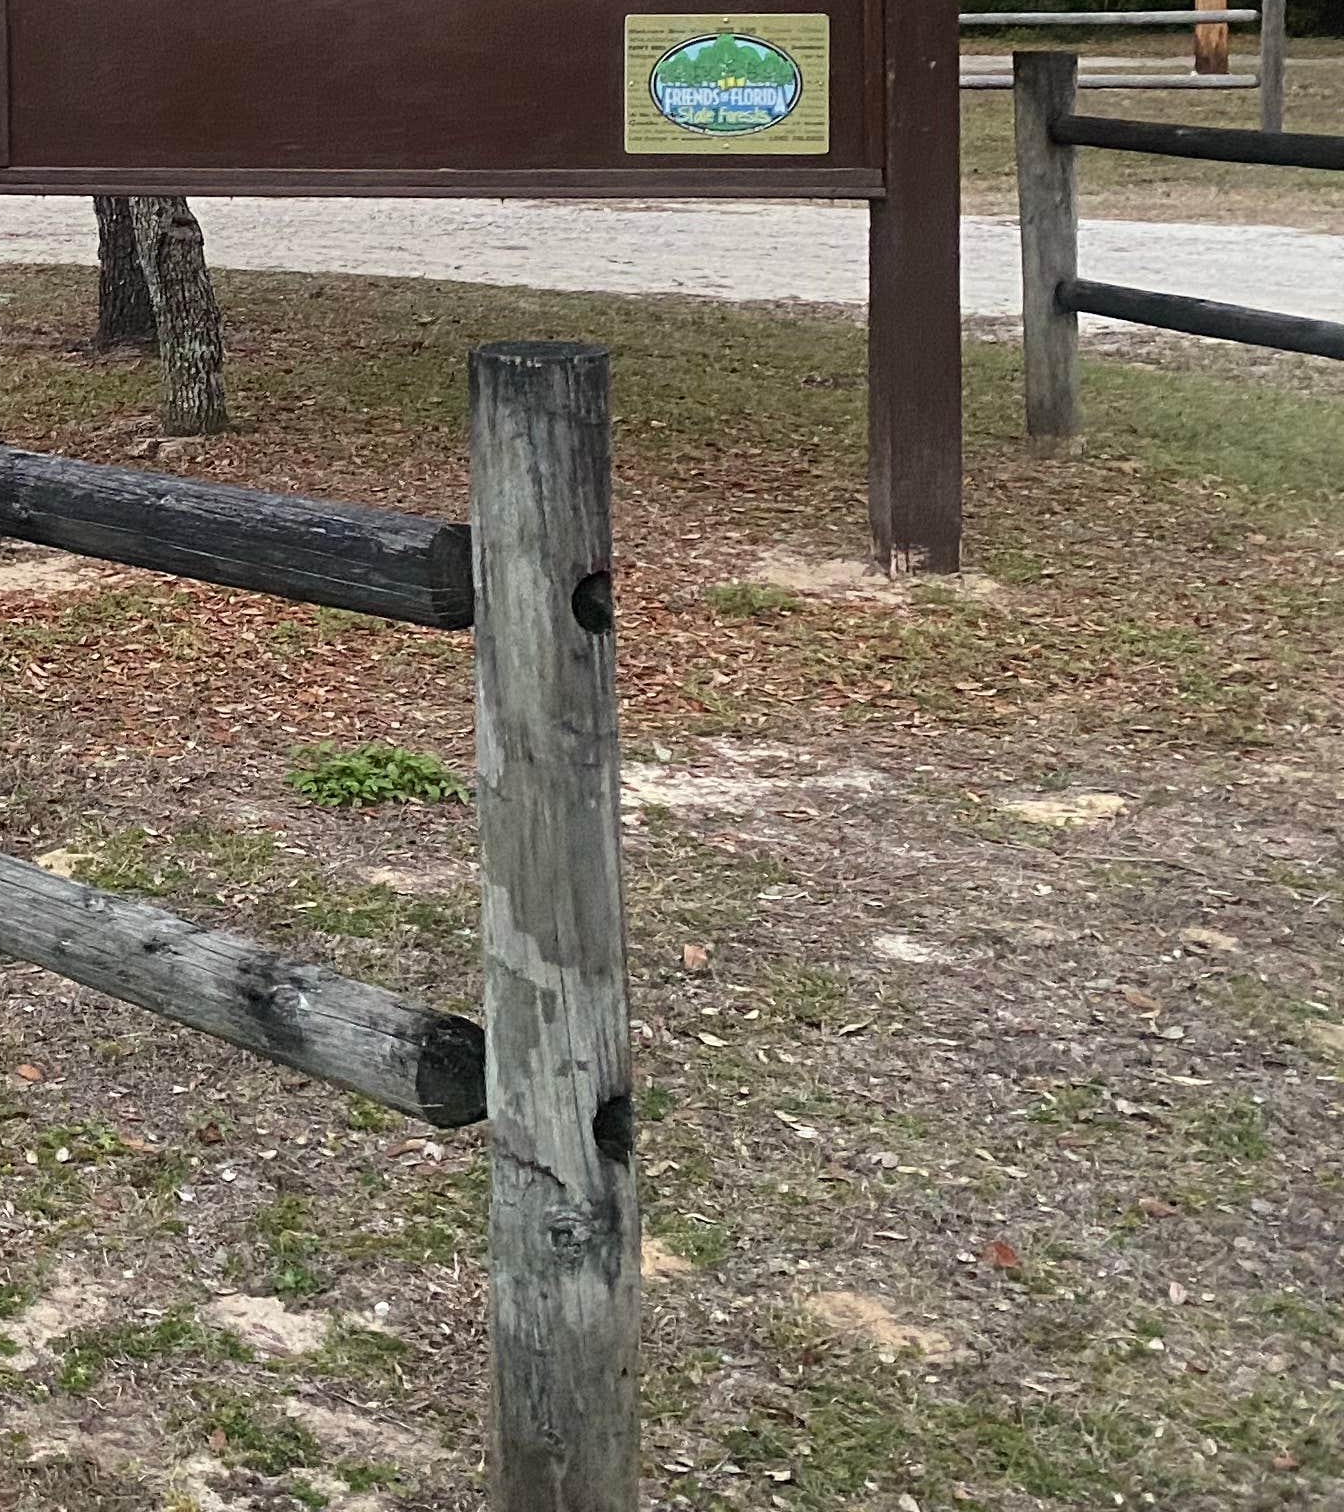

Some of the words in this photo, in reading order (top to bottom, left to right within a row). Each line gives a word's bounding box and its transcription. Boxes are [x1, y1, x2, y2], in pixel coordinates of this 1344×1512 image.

[664, 87, 720, 114] FRIENDS
[730, 86, 788, 114] FLORIDA
[677, 106, 714, 123] State
